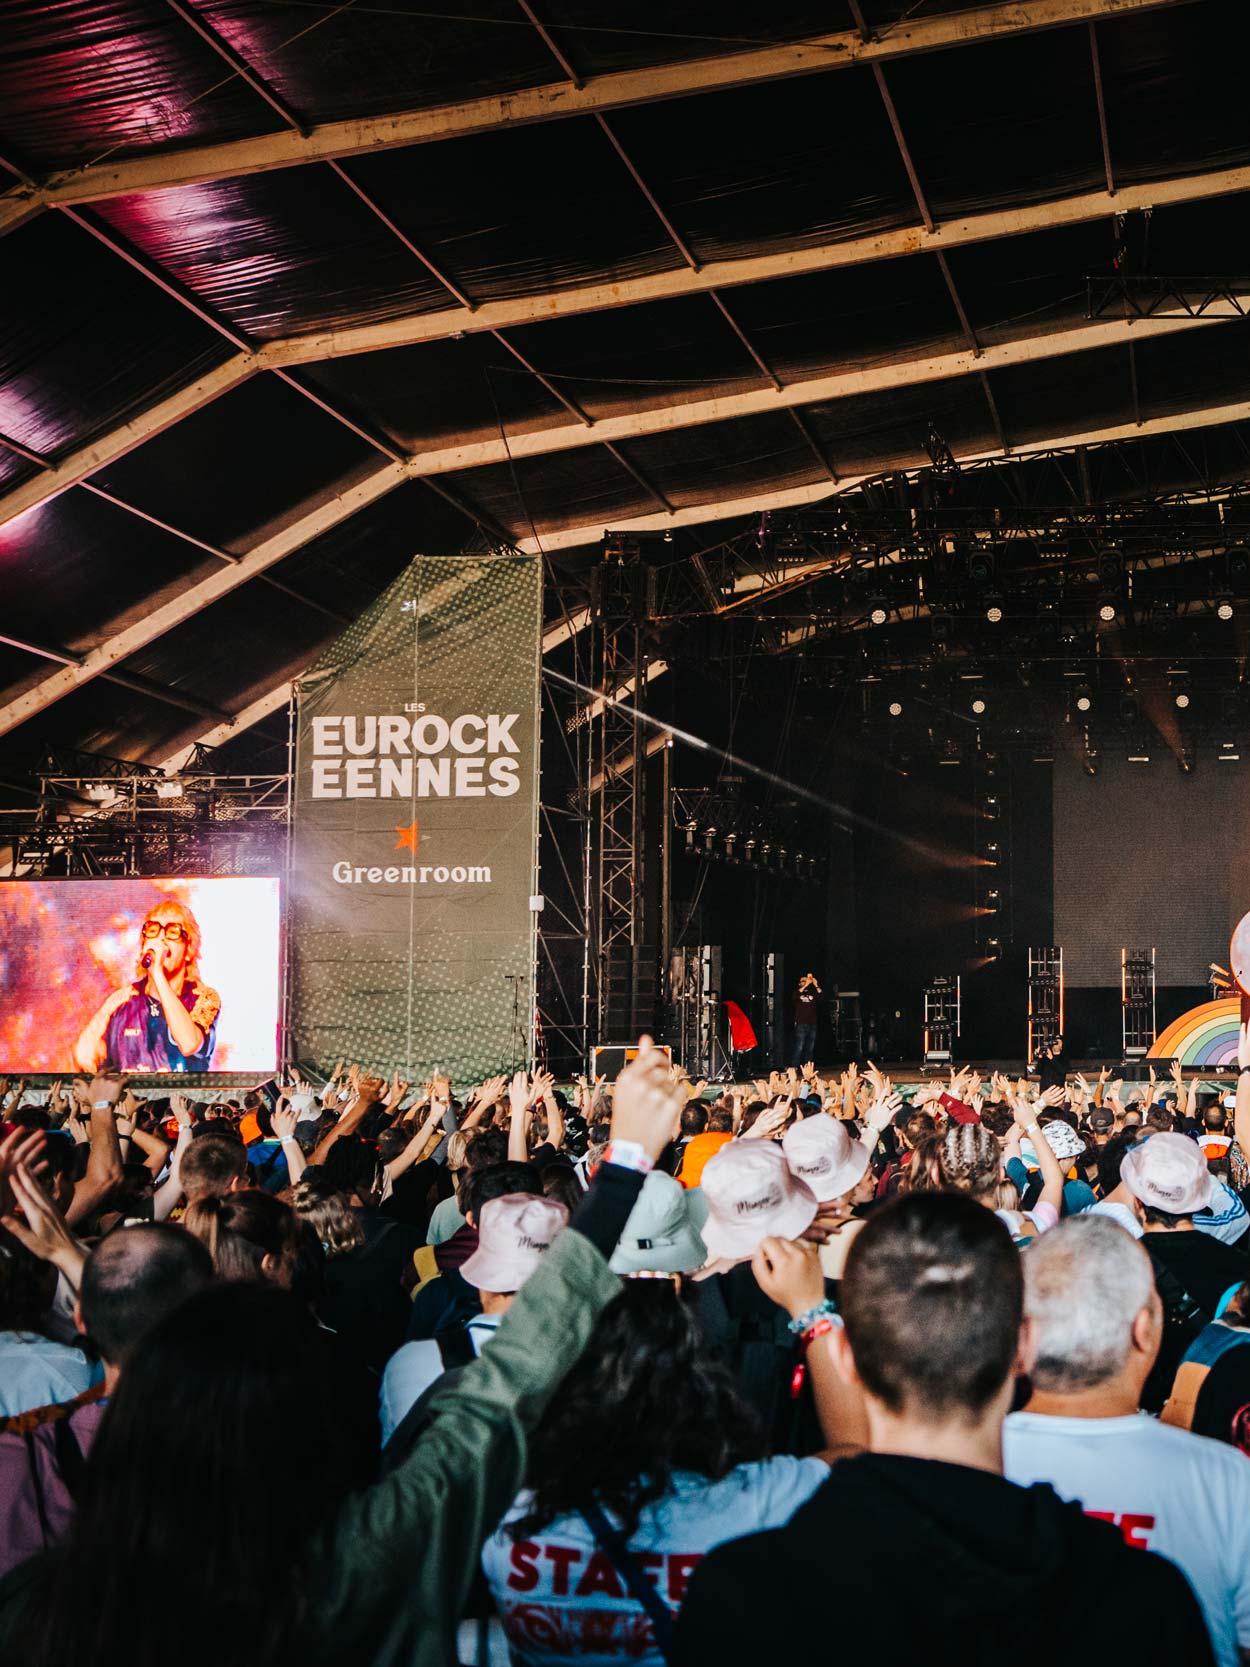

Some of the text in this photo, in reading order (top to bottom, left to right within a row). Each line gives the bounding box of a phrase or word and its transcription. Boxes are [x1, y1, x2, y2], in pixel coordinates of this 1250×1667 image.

[404, 702, 426, 713] LES
[312, 714, 521, 756] EUROCK
[312, 757, 521, 798] EENNES
[332, 861, 492, 884] Greenroom
